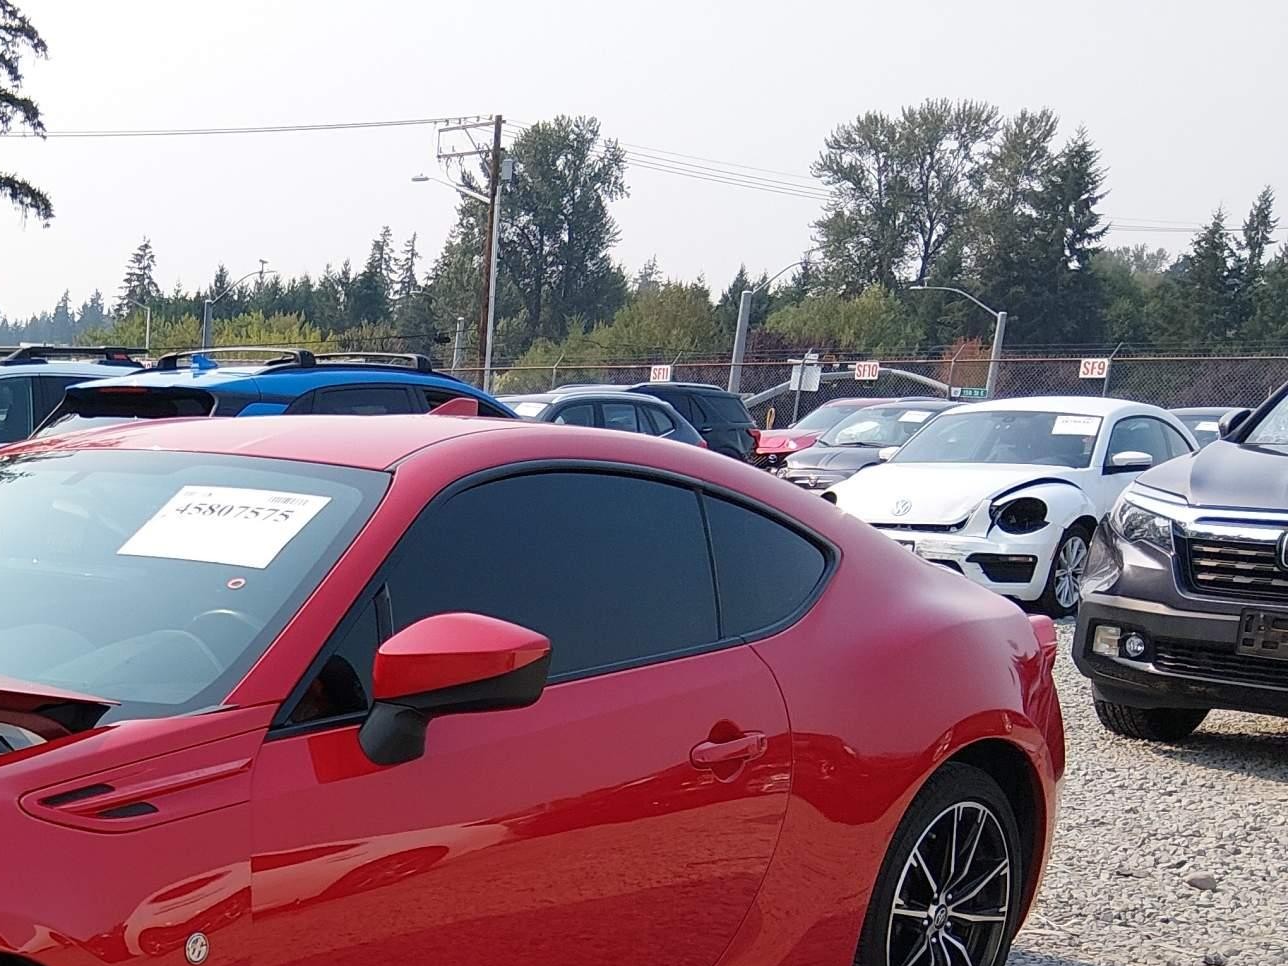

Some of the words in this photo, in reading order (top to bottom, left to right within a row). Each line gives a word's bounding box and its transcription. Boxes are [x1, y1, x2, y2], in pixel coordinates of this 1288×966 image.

[652, 367, 669, 380] SF11
[857, 364, 878, 378] SF10
[1082, 361, 1106, 376] SF9
[176, 503, 294, 522] 45807575
